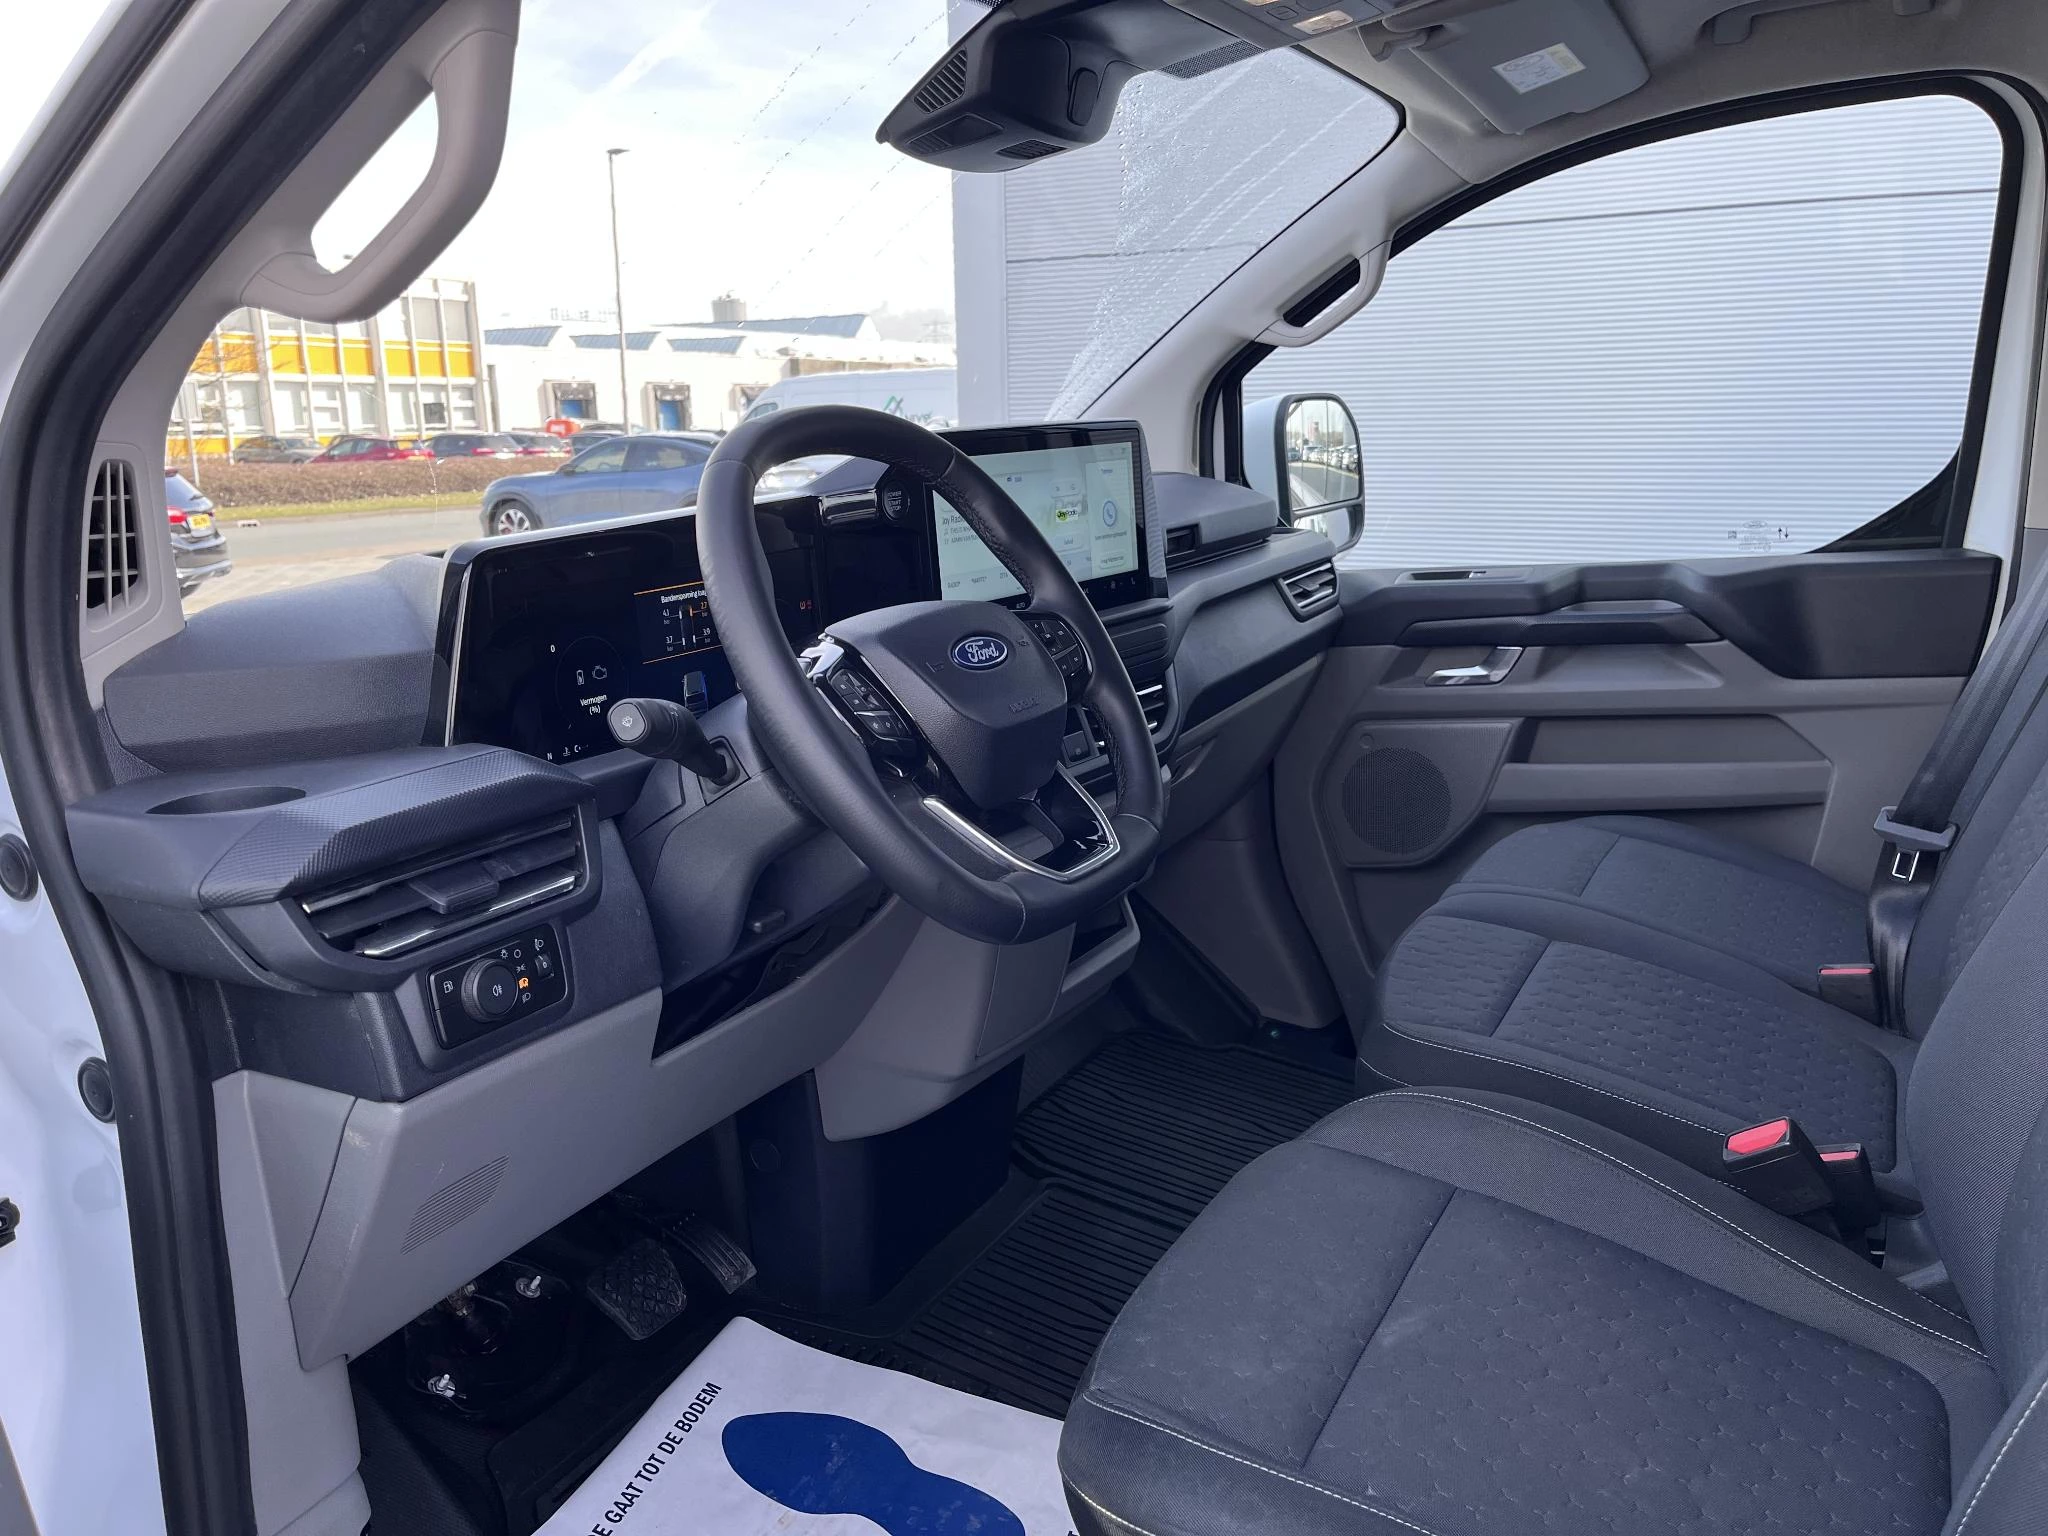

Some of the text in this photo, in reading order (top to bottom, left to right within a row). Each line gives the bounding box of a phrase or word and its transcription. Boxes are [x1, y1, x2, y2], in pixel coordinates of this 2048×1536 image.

[965, 640, 999, 662] Ford
[580, 694, 608, 707] Vermogen
[547, 752, 553, 760] N
[588, 1382, 723, 1536] E GAAT TOT DE BODEM
